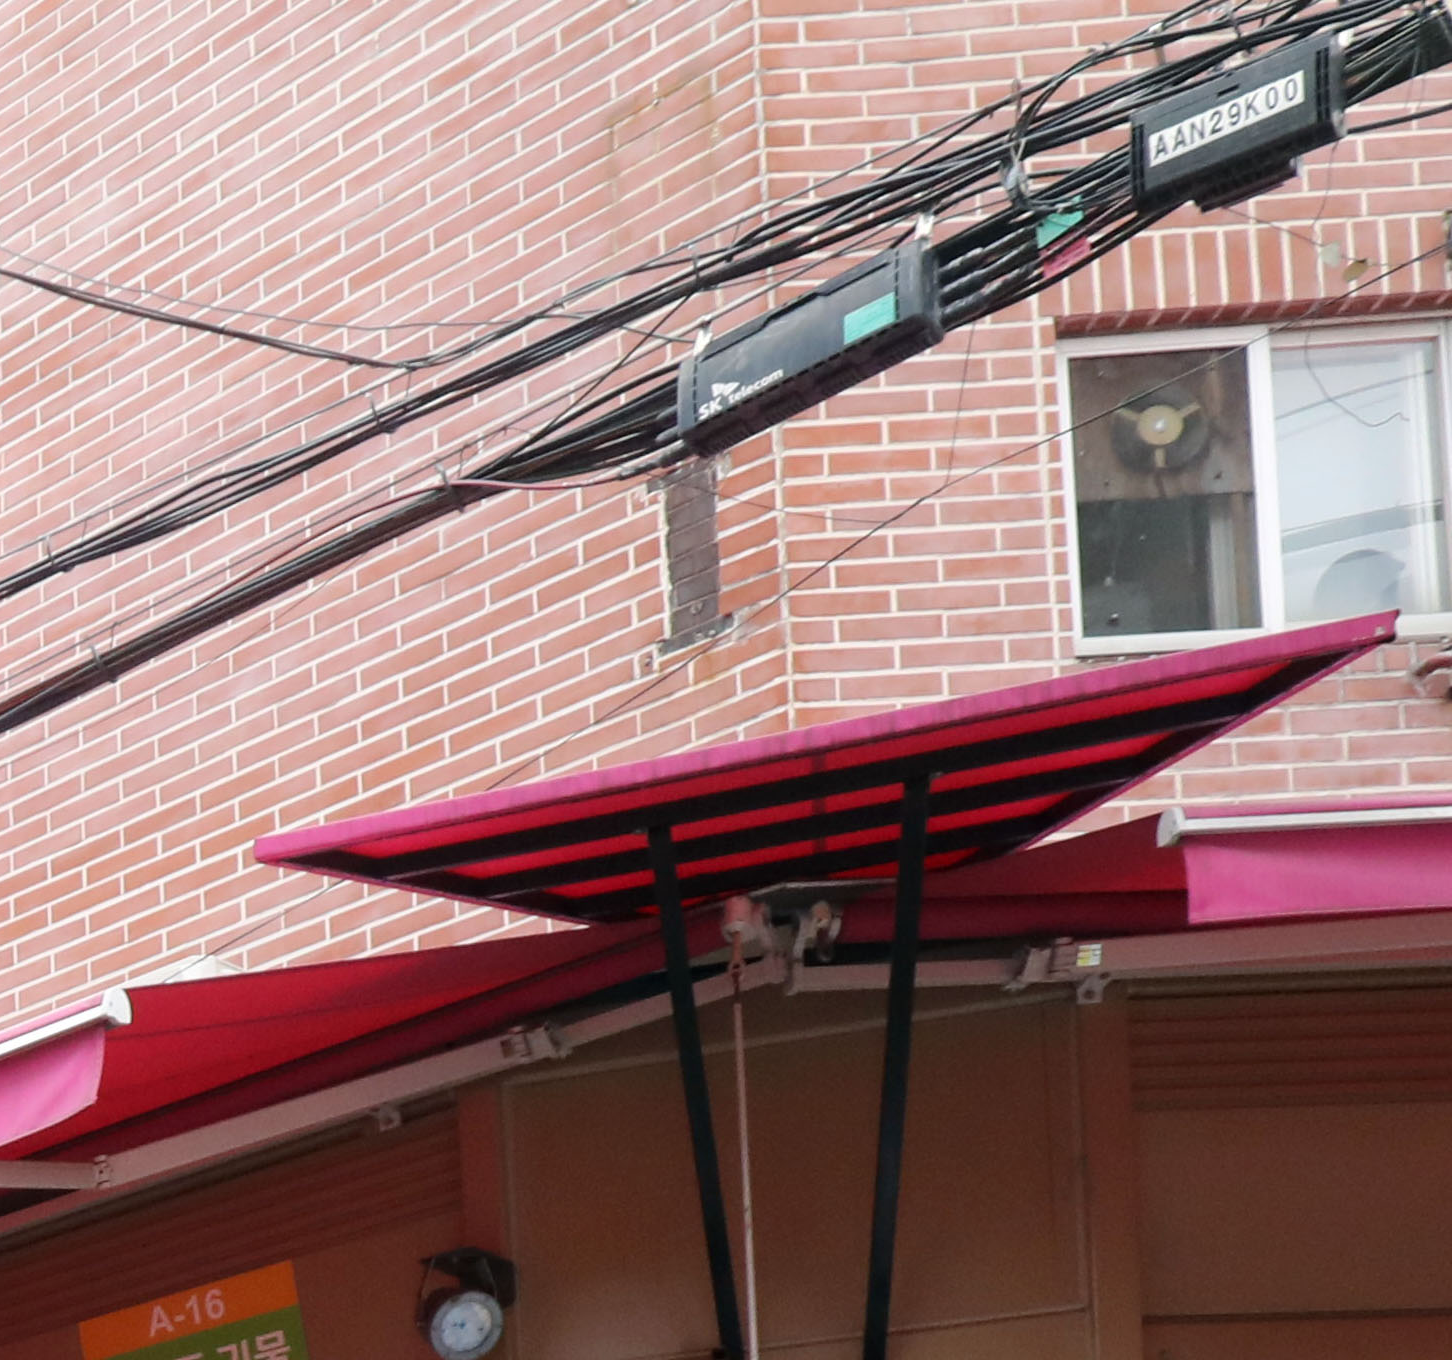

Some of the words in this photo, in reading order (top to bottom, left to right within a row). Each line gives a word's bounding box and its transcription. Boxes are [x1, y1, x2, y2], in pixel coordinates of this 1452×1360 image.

[1152, 78, 1298, 161] AAN29K00
[698, 397, 723, 421] SK
[729, 368, 784, 404] telecom
[148, 1288, 227, 1338] A-16
